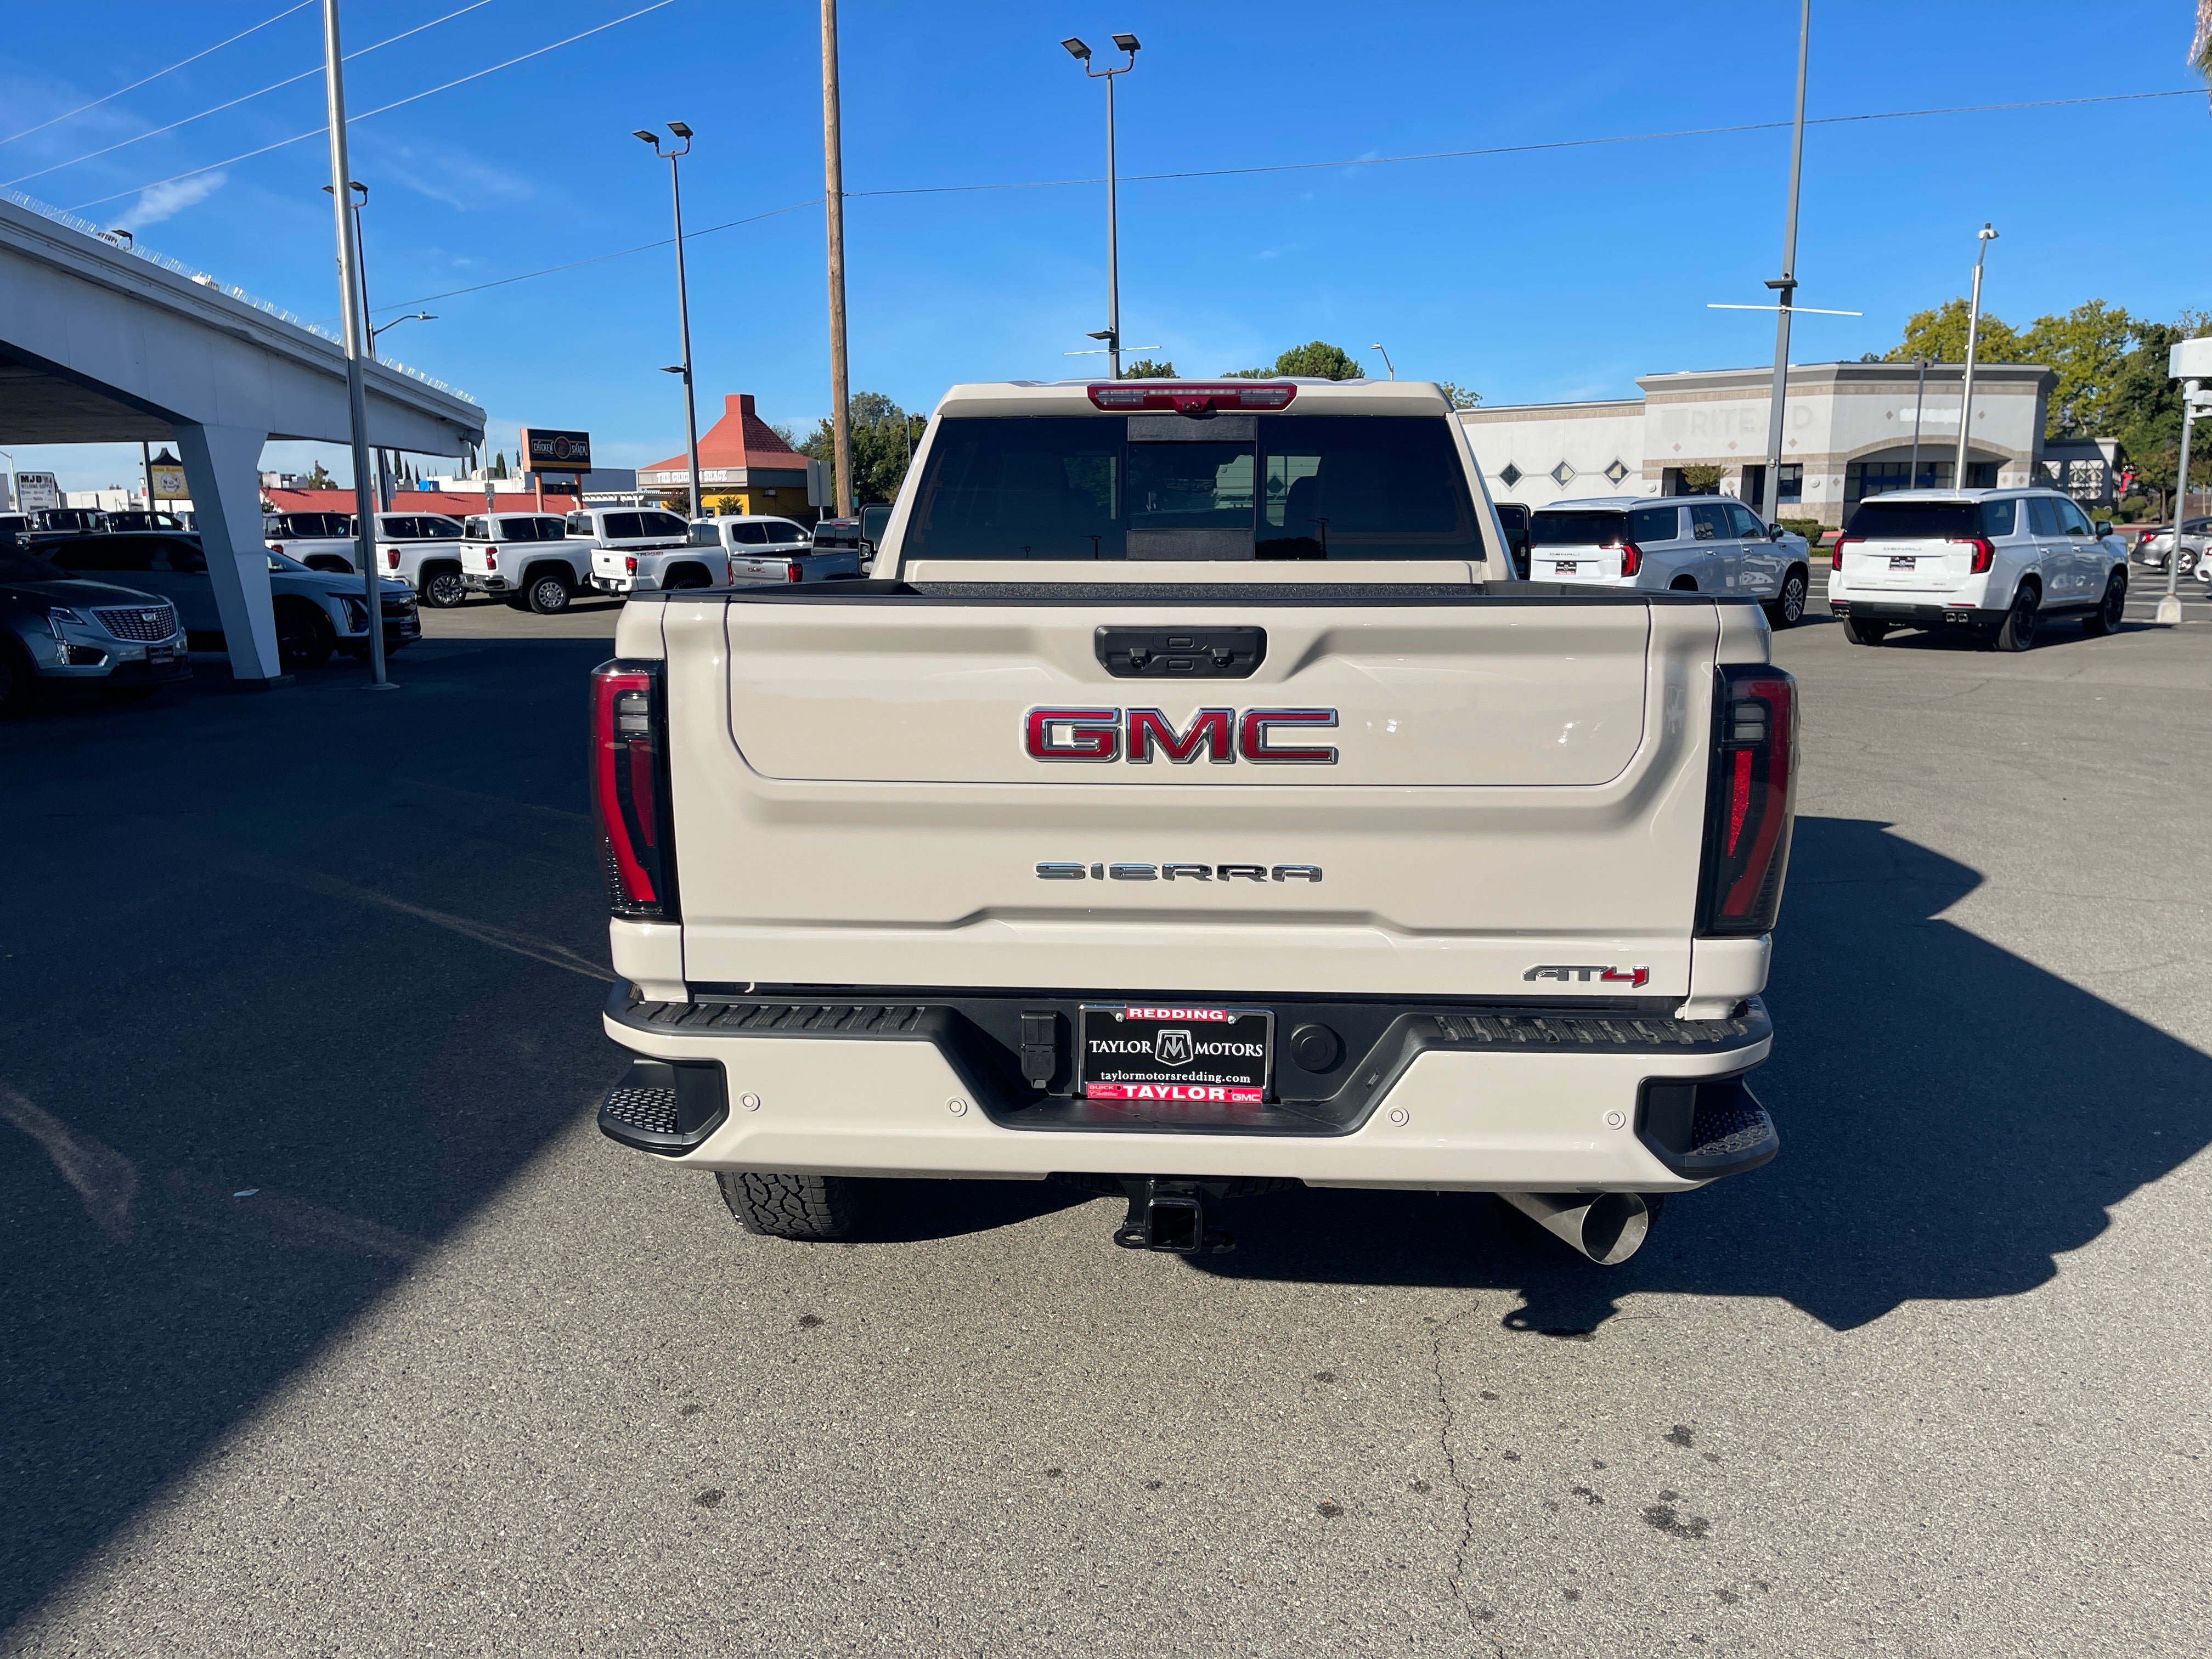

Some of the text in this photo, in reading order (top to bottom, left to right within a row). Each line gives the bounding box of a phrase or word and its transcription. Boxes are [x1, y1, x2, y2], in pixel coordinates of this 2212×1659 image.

[533, 441, 588, 456] CHICKEN SHACK
[657, 470, 727, 483] THE CHIC SHACK
[1025, 707, 1338, 764] GMC
[1035, 862, 1323, 883] SIERRA
[1523, 965, 1650, 988] AT4
[1129, 1008, 1224, 1020] REDDING
[1089, 1040, 1153, 1054] TAYLOR
[1194, 1042, 1263, 1057] MOTORS
[1101, 1070, 1251, 1083] taylormotorsredding.com
[1122, 1086, 1261, 1102] TAYLOR GMC
